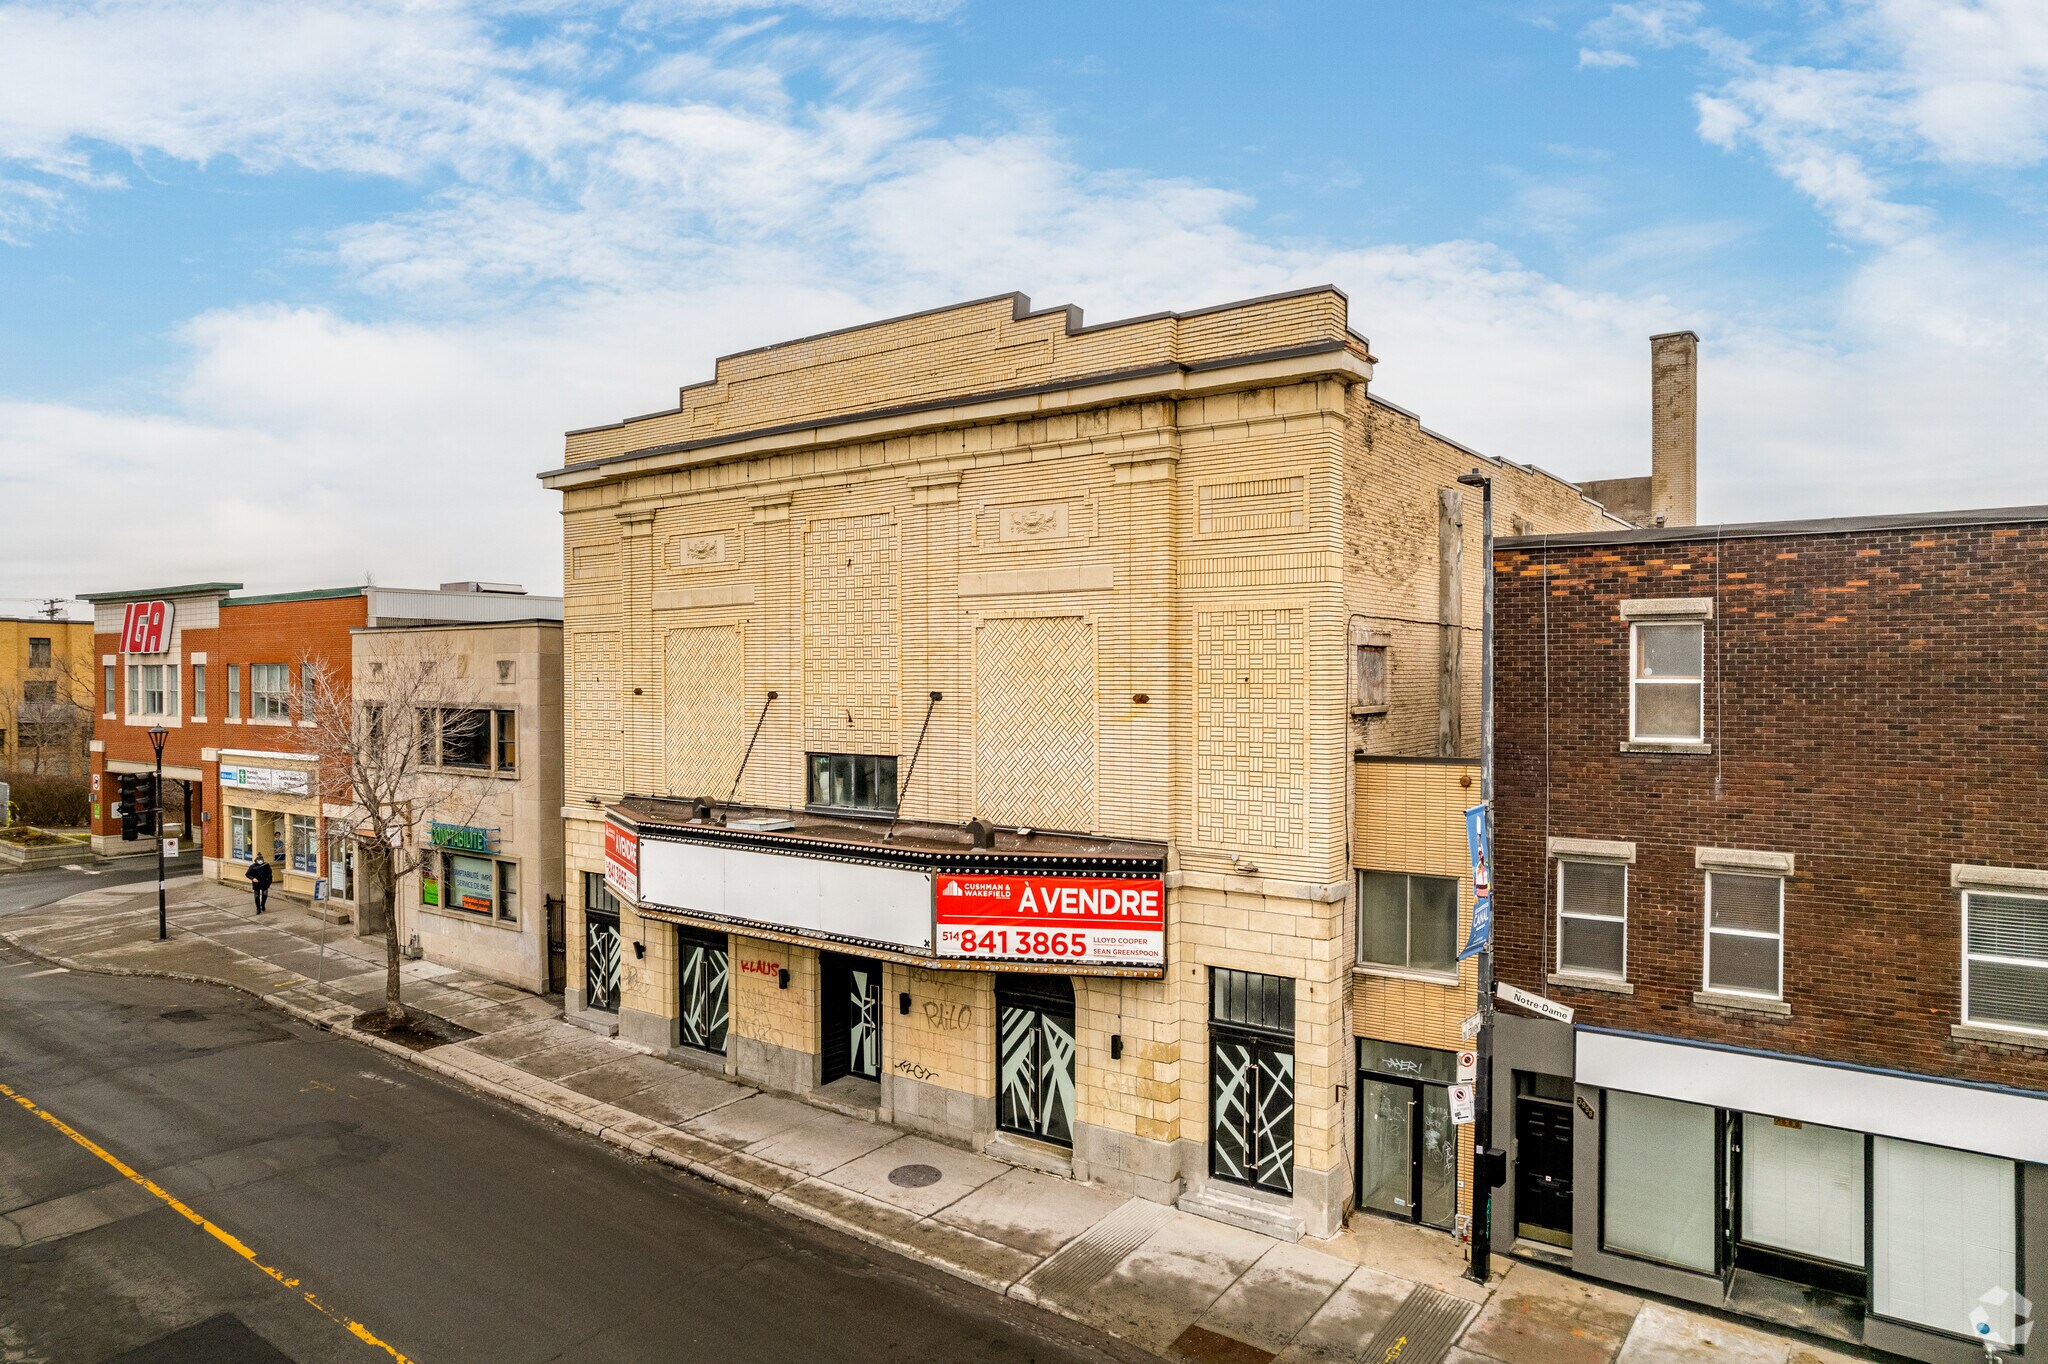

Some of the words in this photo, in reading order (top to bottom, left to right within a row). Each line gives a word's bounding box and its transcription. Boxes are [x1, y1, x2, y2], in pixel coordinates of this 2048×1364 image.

[119, 601, 166, 653] IGA
[964, 883, 1001, 891] CUSHMAN
[1017, 881, 1039, 913] À
[1040, 887, 1159, 917] VENDRE
[942, 931, 960, 941] 514
[960, 929, 1008, 954] 841
[1015, 931, 1087, 957] 3865
[1112, 949, 1159, 957] GREENSPOON
[741, 959, 780, 977] KLAUS
[1513, 993, 1568, 1020] Notre-Dame
